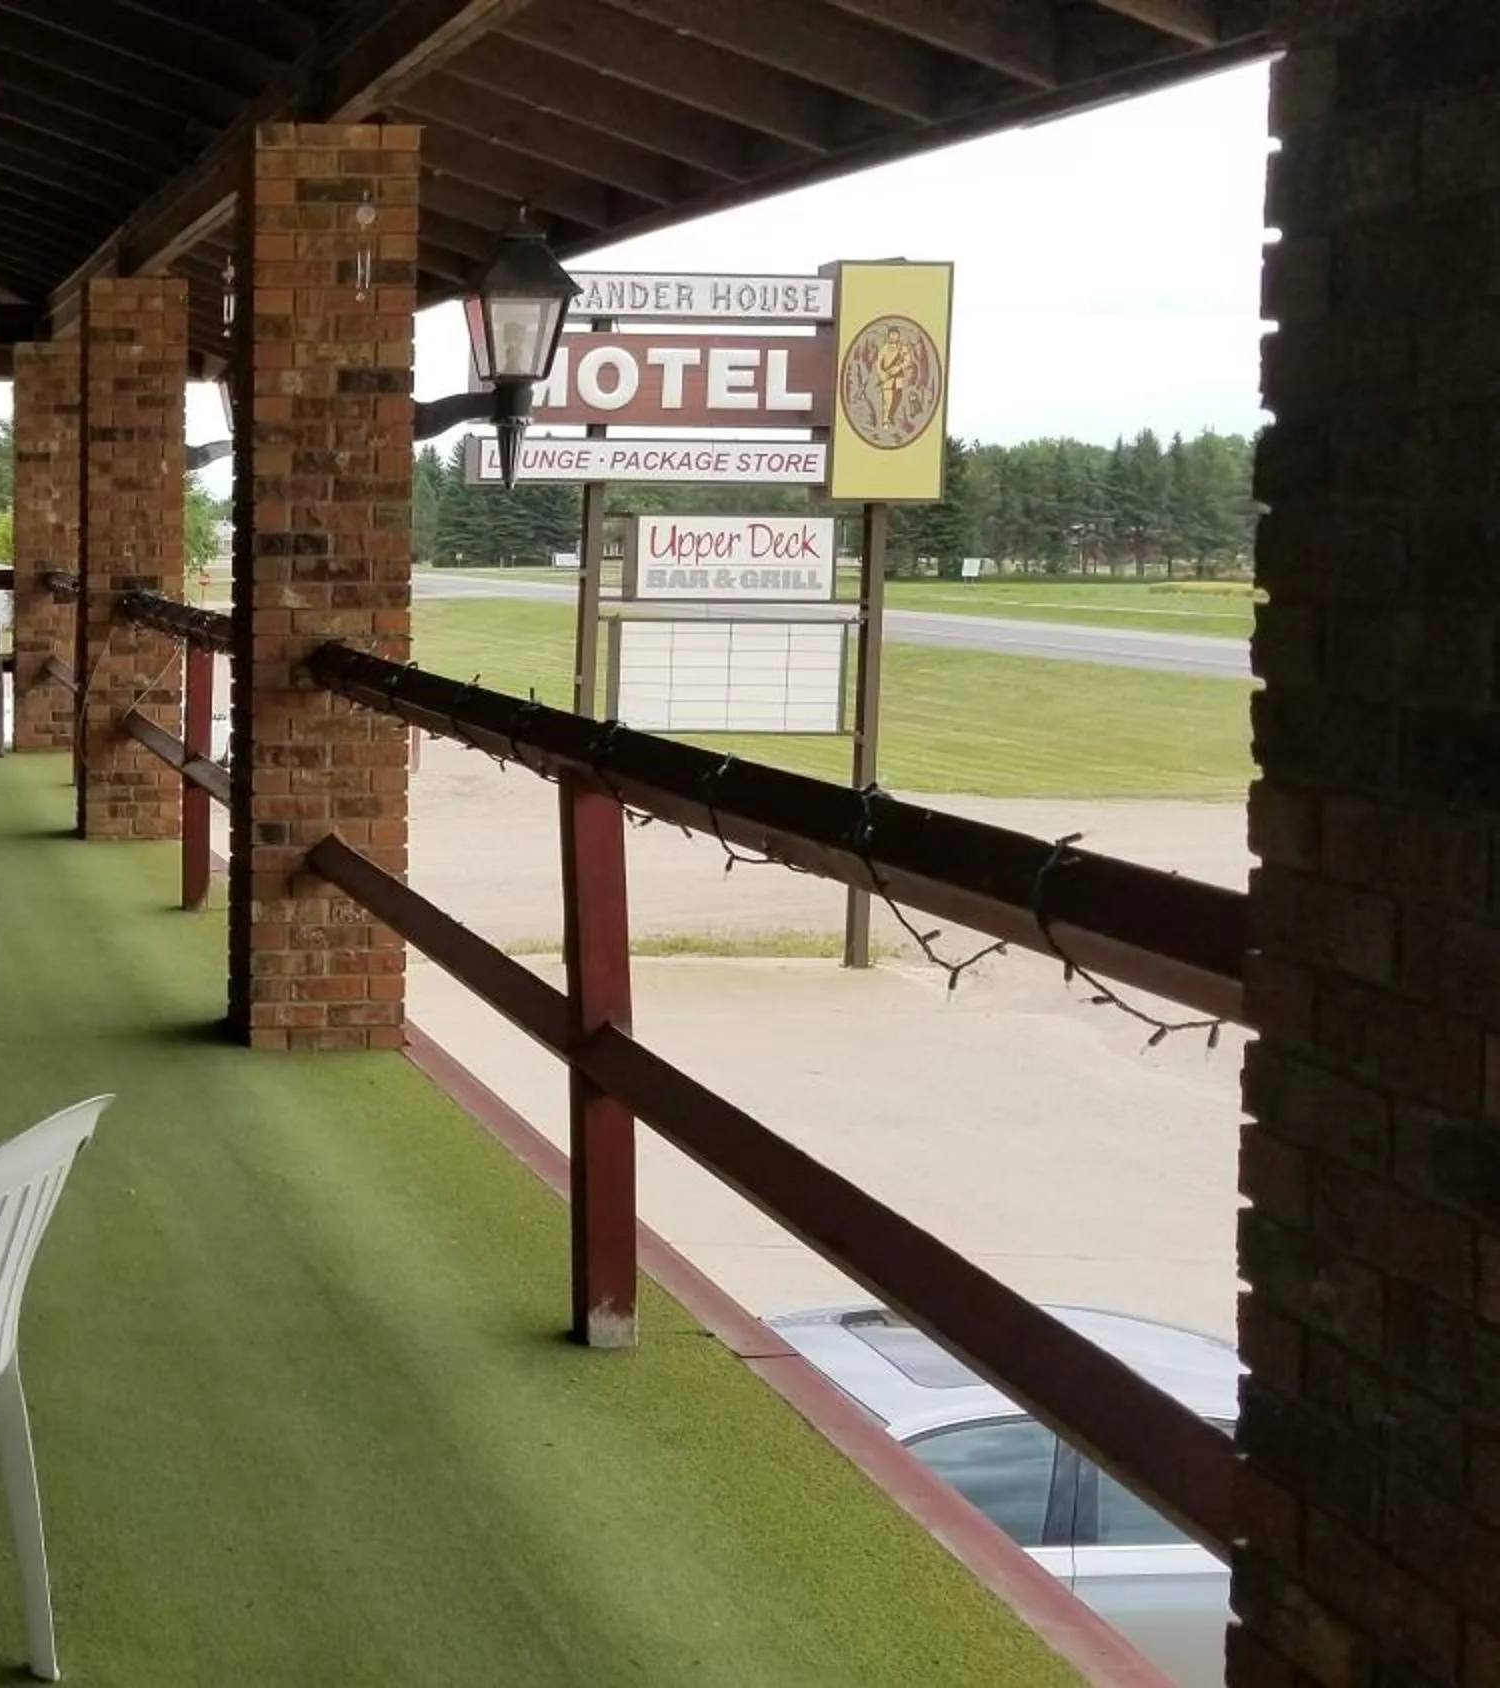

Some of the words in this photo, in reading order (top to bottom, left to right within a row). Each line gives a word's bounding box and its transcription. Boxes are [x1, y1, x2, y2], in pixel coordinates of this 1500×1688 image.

[572, 280, 694, 311] ANDER
[710, 281, 822, 313] HOUSE
[487, 449, 592, 470] LUNGE
[609, 451, 731, 472] PACKAGE
[735, 452, 819, 474] STORE
[649, 523, 741, 567] Upper
[746, 523, 821, 560] Deck
[646, 569, 710, 589] BAR
[713, 568, 738, 589] &
[739, 569, 823, 590] GRILL
